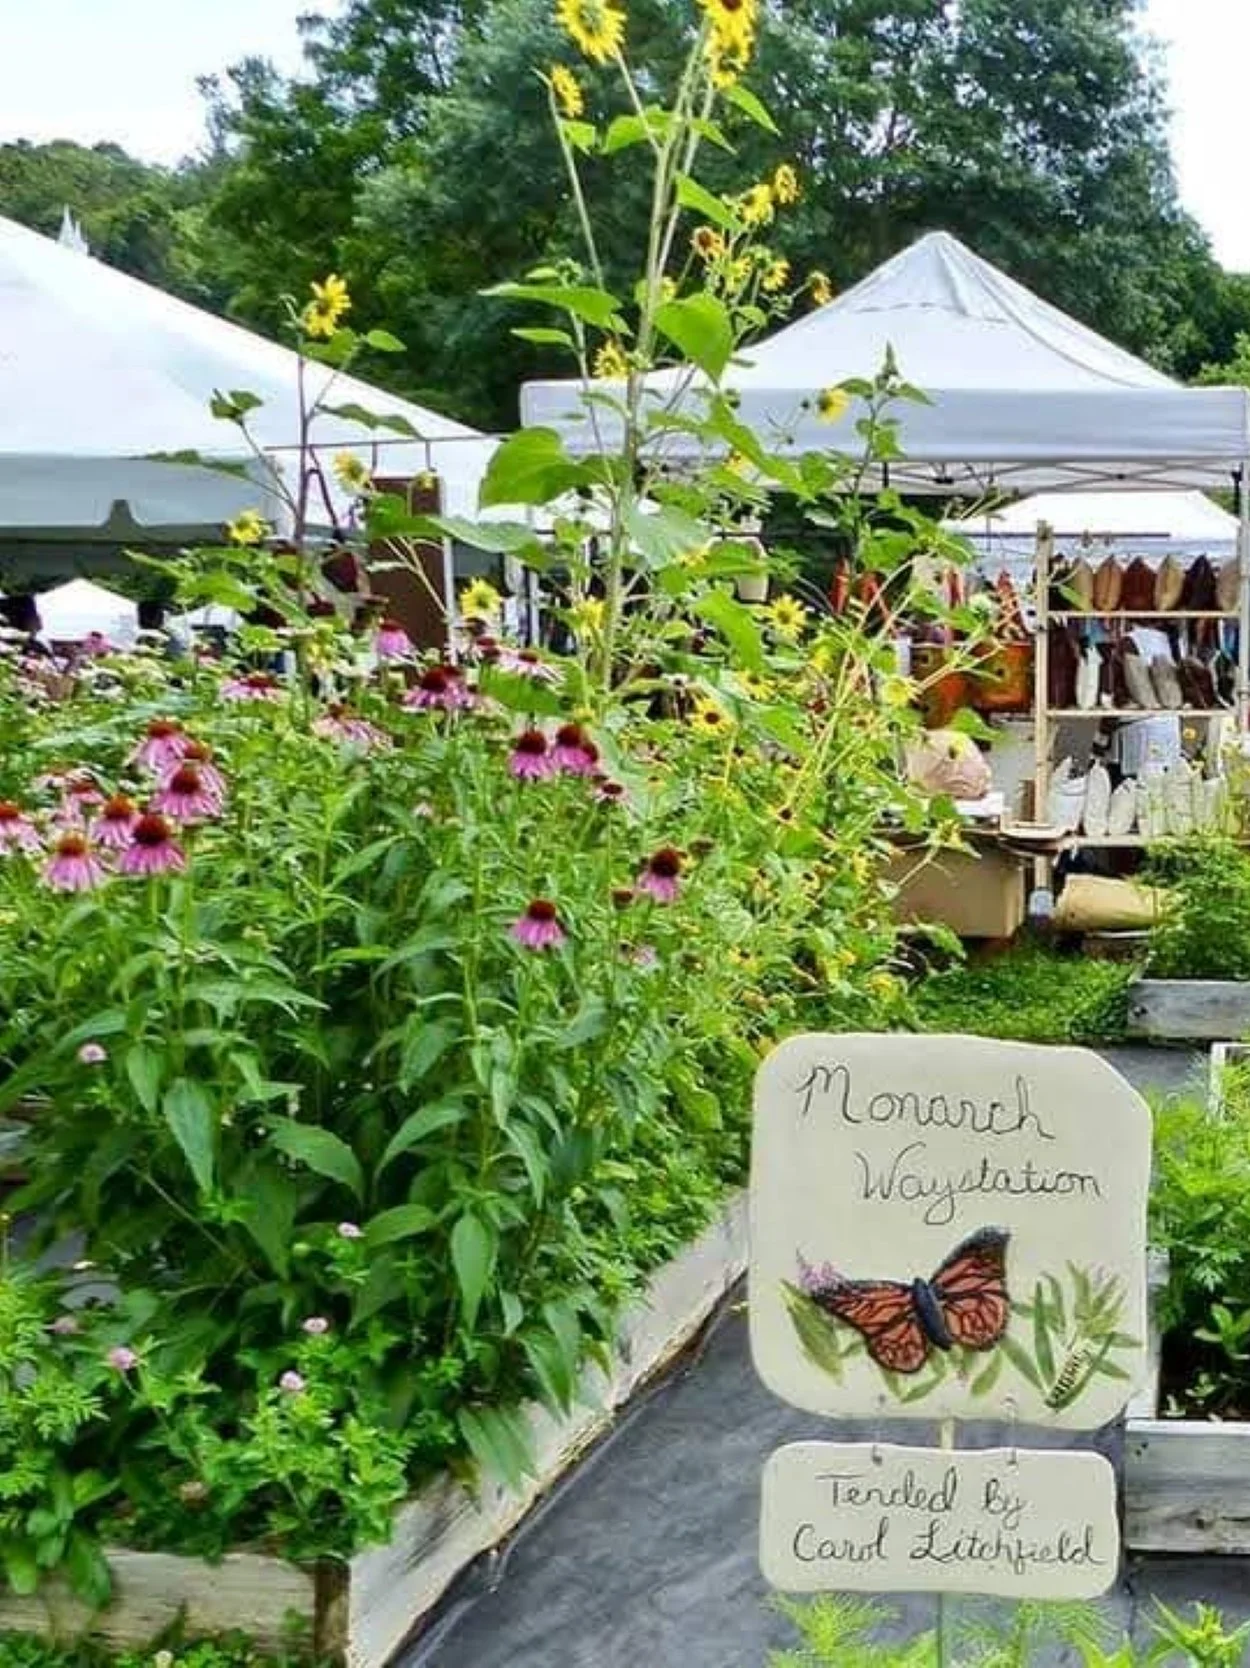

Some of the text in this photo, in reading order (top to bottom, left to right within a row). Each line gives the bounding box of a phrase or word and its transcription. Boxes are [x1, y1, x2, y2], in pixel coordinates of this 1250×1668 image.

[797, 1065, 1056, 1140] Monarch
[853, 1141, 1101, 1226] Waystation
[815, 1466, 957, 1513] Tended
[793, 1516, 1105, 1575] Carol Litchfield
